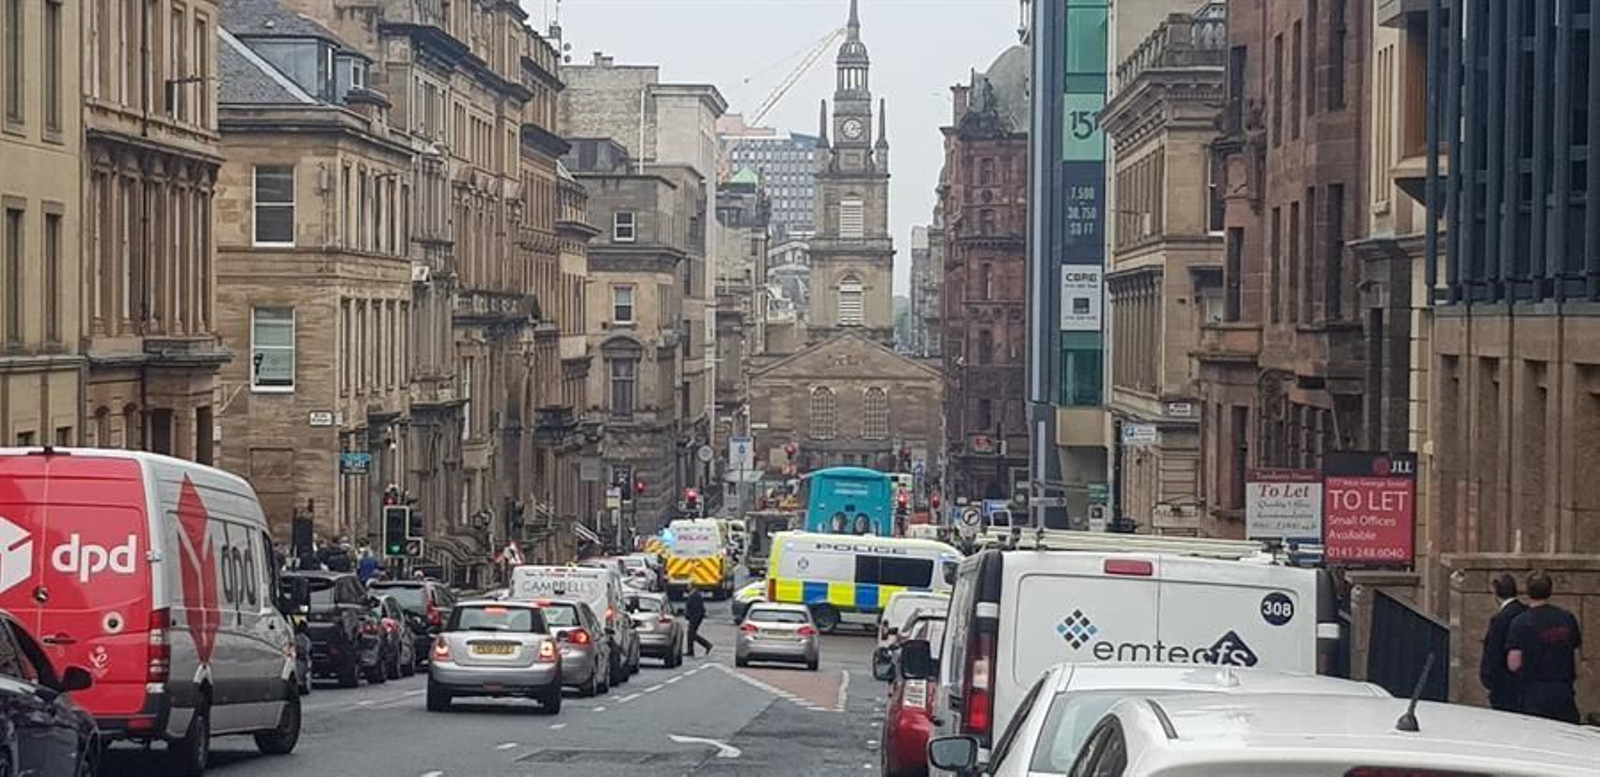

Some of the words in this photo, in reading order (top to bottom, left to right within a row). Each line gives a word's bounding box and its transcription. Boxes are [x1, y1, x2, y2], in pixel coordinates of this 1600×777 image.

[1069, 110, 1098, 140] 151
[1390, 460, 1413, 474] JLL
[1258, 483, 1279, 498] To
[1282, 483, 1310, 498] Let
[1329, 489, 1362, 511] TO
[1368, 490, 1409, 512] LET
[1328, 514, 1358, 526] Small
[1359, 515, 1397, 528] Offices
[1328, 530, 1377, 541] Available
[815, 542, 907, 555] POLICE
[51, 533, 138, 583] dpd
[220, 519, 257, 627] dpd
[1262, 601, 1292, 617] 308
